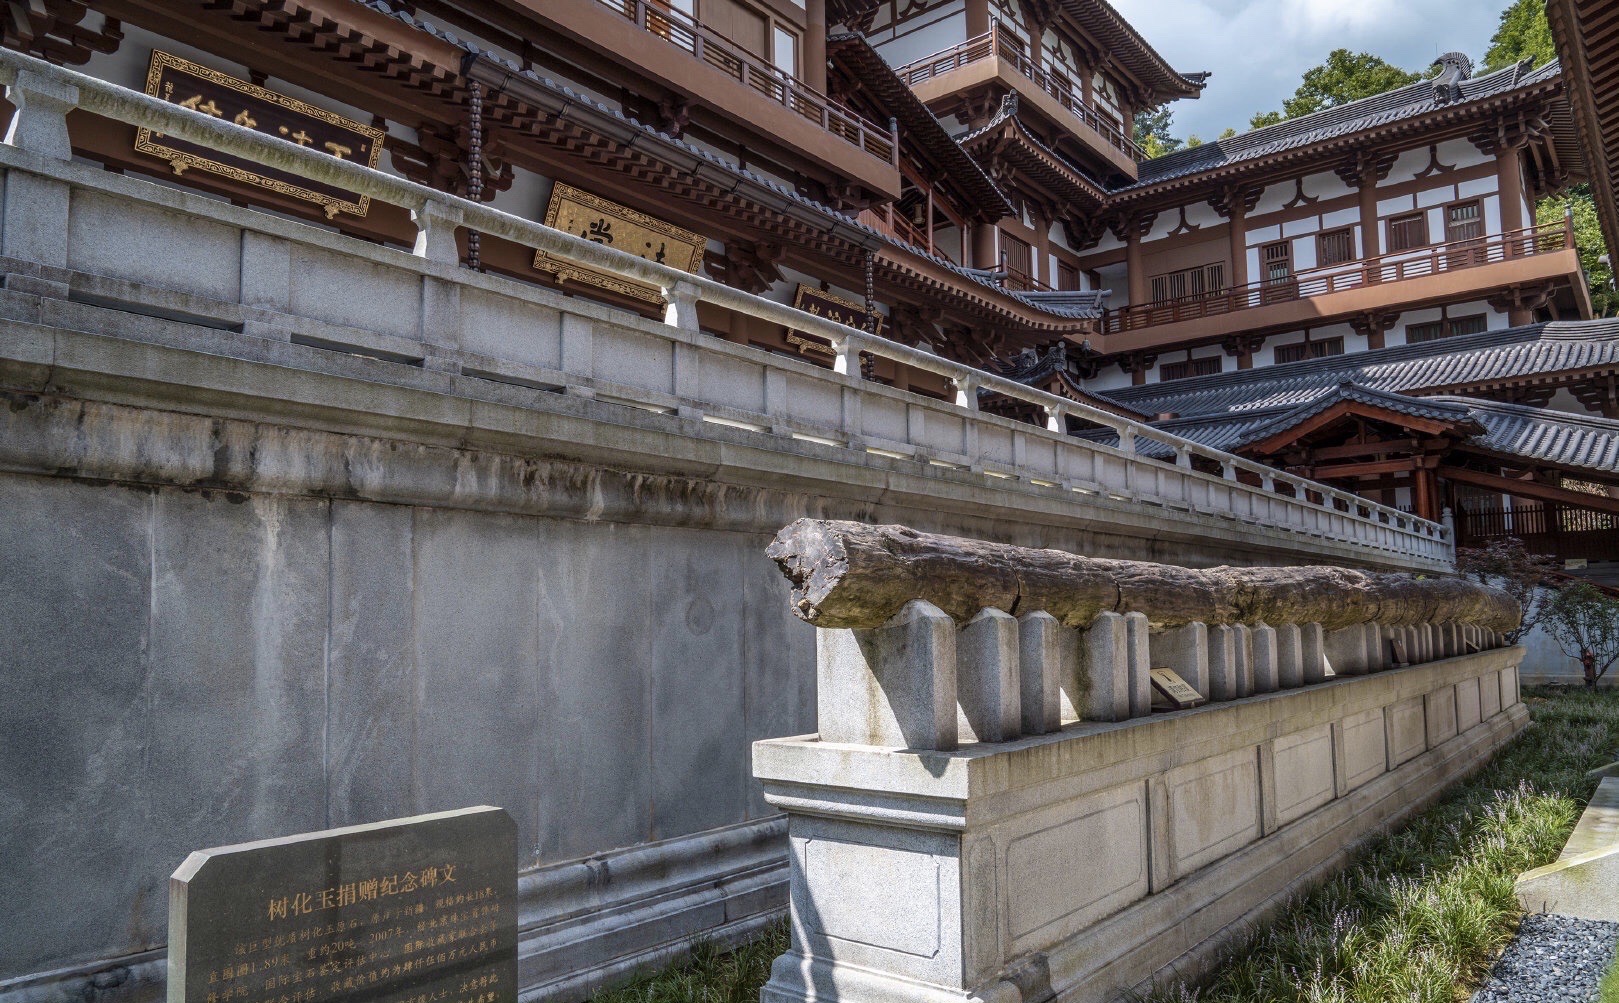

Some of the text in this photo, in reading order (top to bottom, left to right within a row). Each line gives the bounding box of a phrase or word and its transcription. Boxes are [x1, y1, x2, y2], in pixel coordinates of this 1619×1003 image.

[267, 863, 457, 921] 树化玉捐赠纪念碑文
